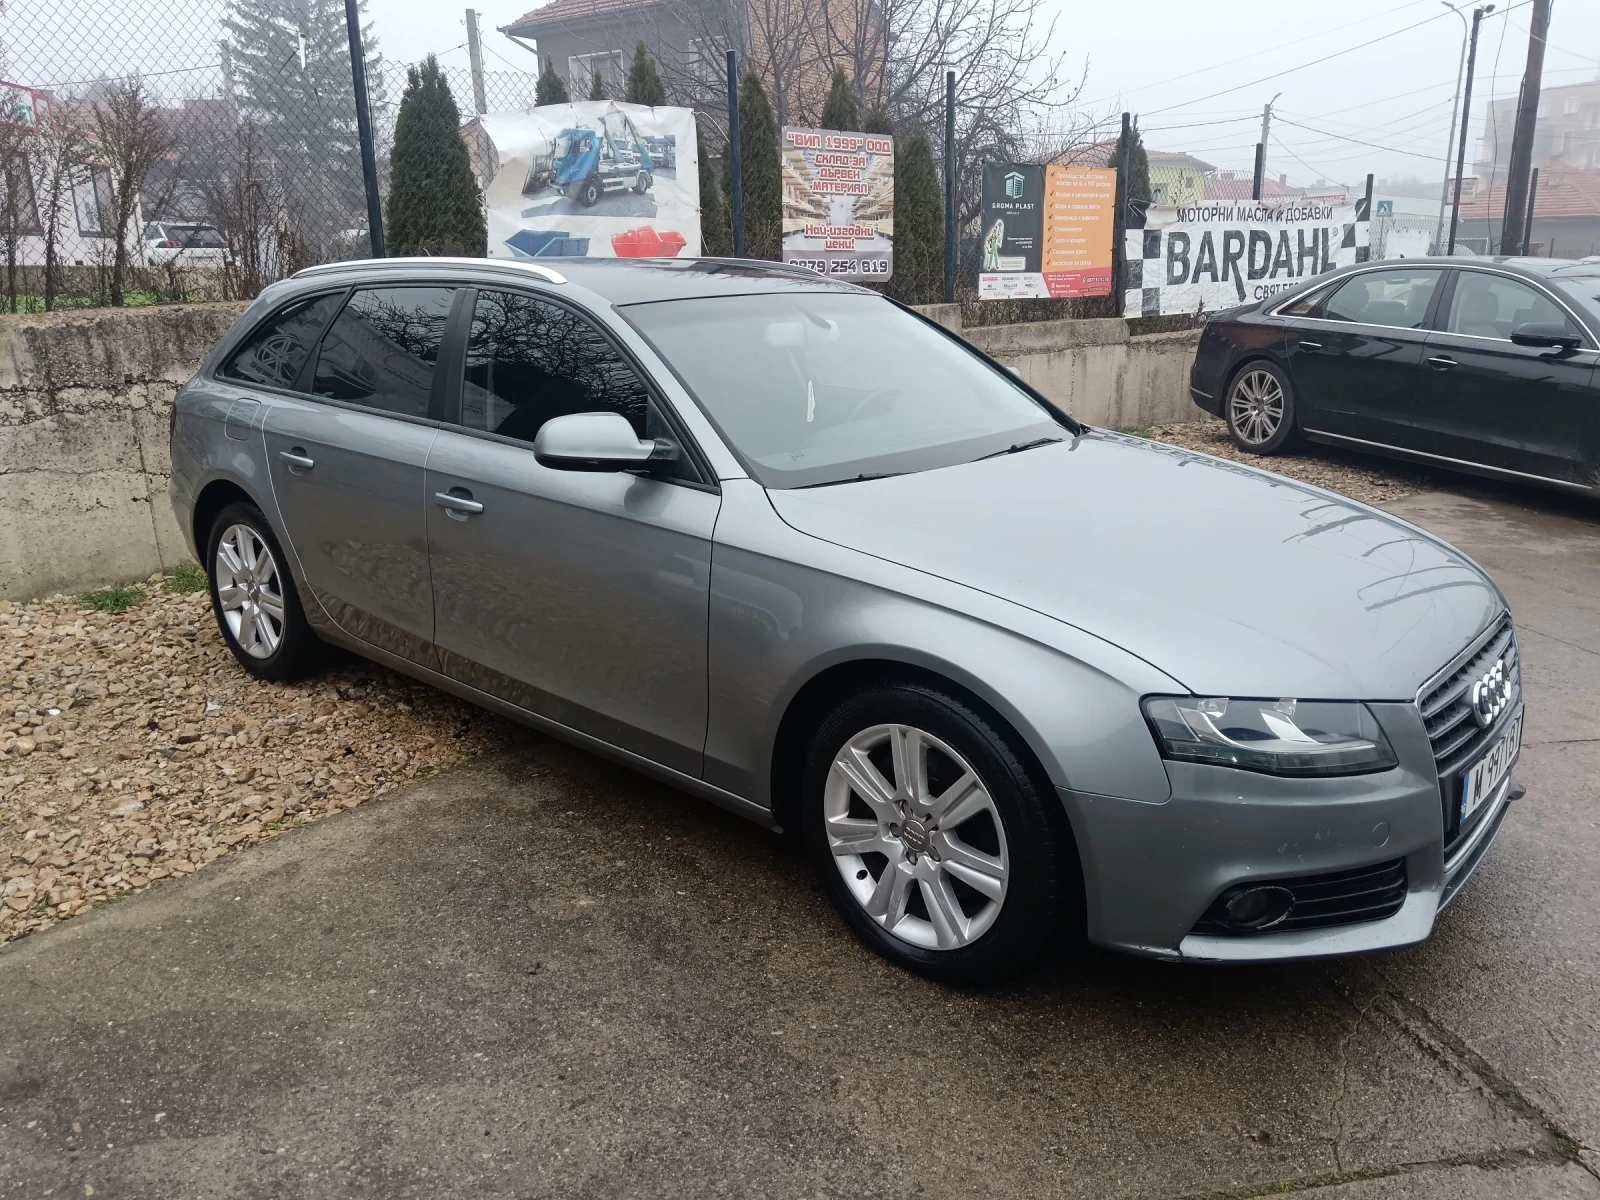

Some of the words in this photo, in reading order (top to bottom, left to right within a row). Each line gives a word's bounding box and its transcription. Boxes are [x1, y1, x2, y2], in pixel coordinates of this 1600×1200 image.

[866, 139, 891, 153] ООД
[815, 154, 849, 165] СКЛАД
[852, 156, 866, 166] ЗА
[819, 168, 860, 179] ДЪРВЕН
[812, 181, 868, 193] МАТЕРИАЛ
[1177, 206, 1233, 222] МОТОРНИ
[1237, 206, 1274, 222] МАСЛА
[1285, 206, 1333, 224] ДОБАВКИ
[825, 238, 855, 249] цени!
[830, 260, 857, 273] 254
[862, 260, 888, 273] 819
[1166, 228, 1337, 302] BARDAHL
[1472, 763, 1485, 806] M
